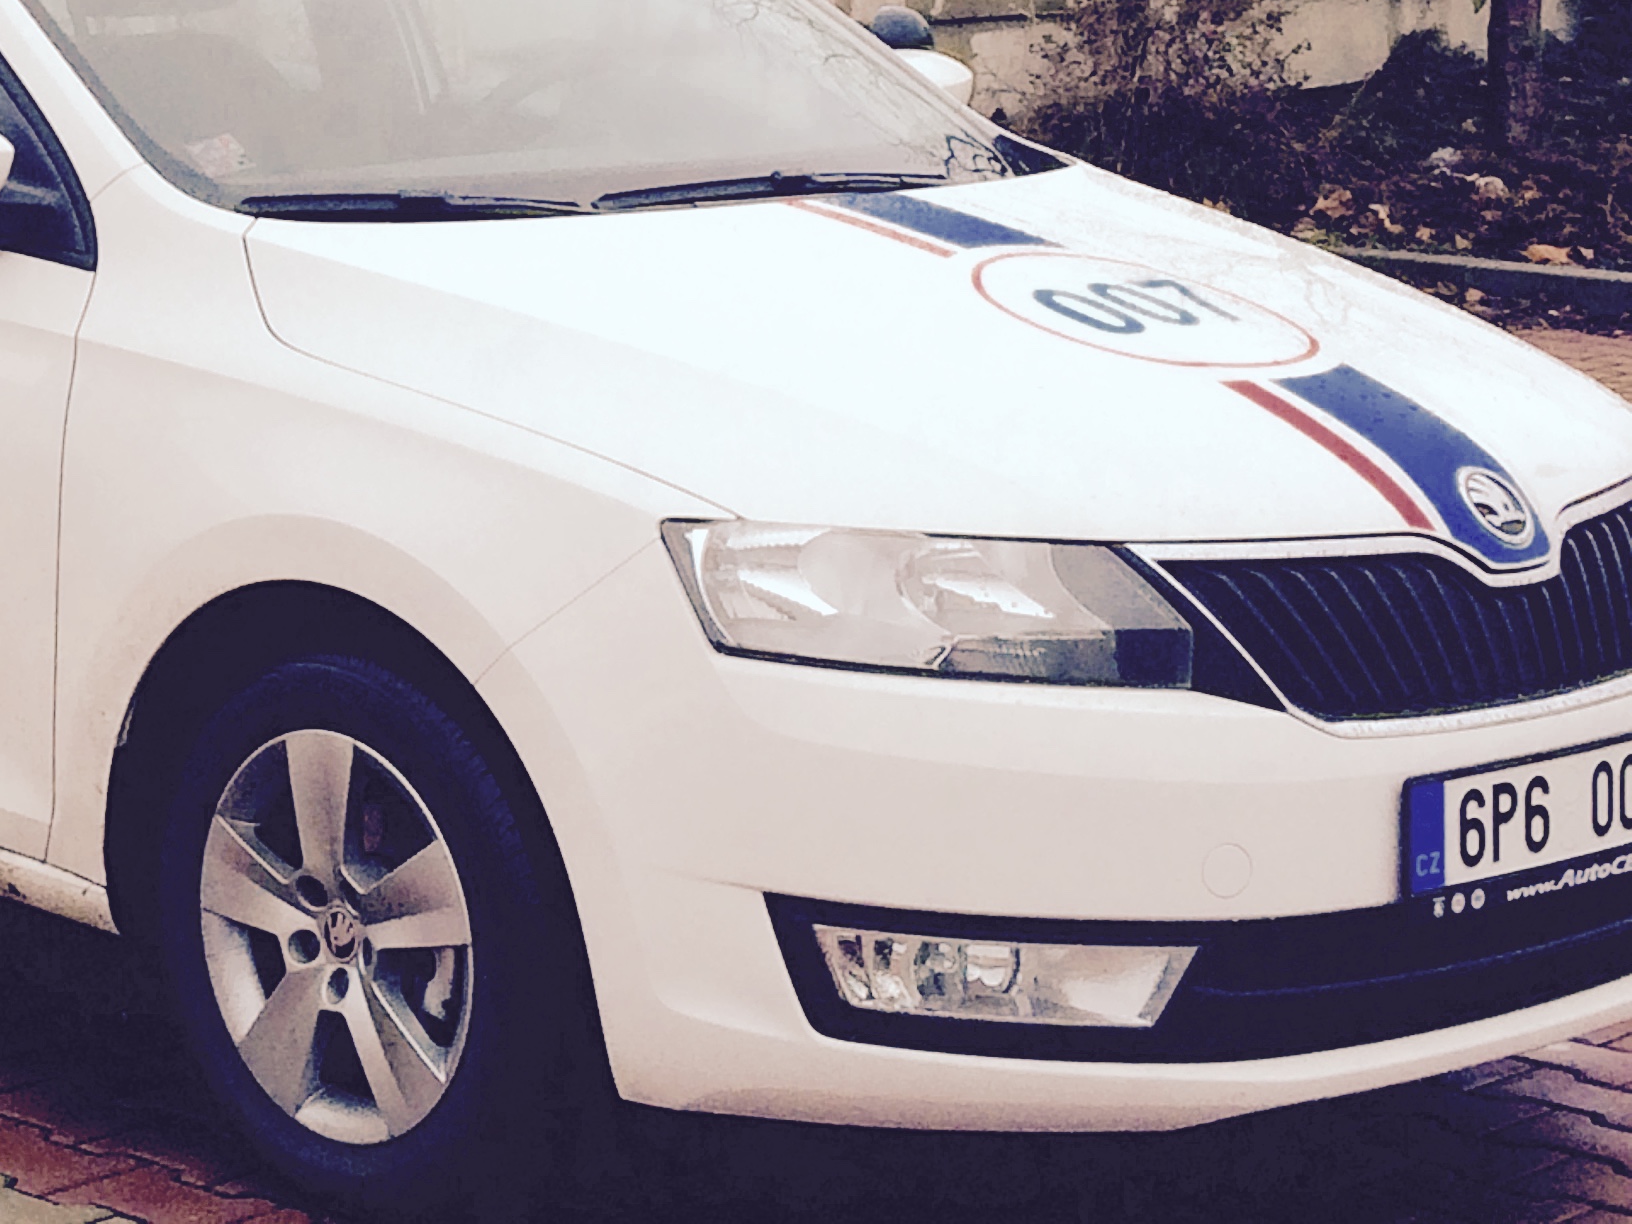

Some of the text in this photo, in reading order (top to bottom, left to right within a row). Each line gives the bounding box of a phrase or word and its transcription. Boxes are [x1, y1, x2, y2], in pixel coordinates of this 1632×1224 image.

[1033, 279, 1241, 334] 007
[1460, 775, 1550, 867] 6P6
[1416, 851, 1440, 876] CZ
